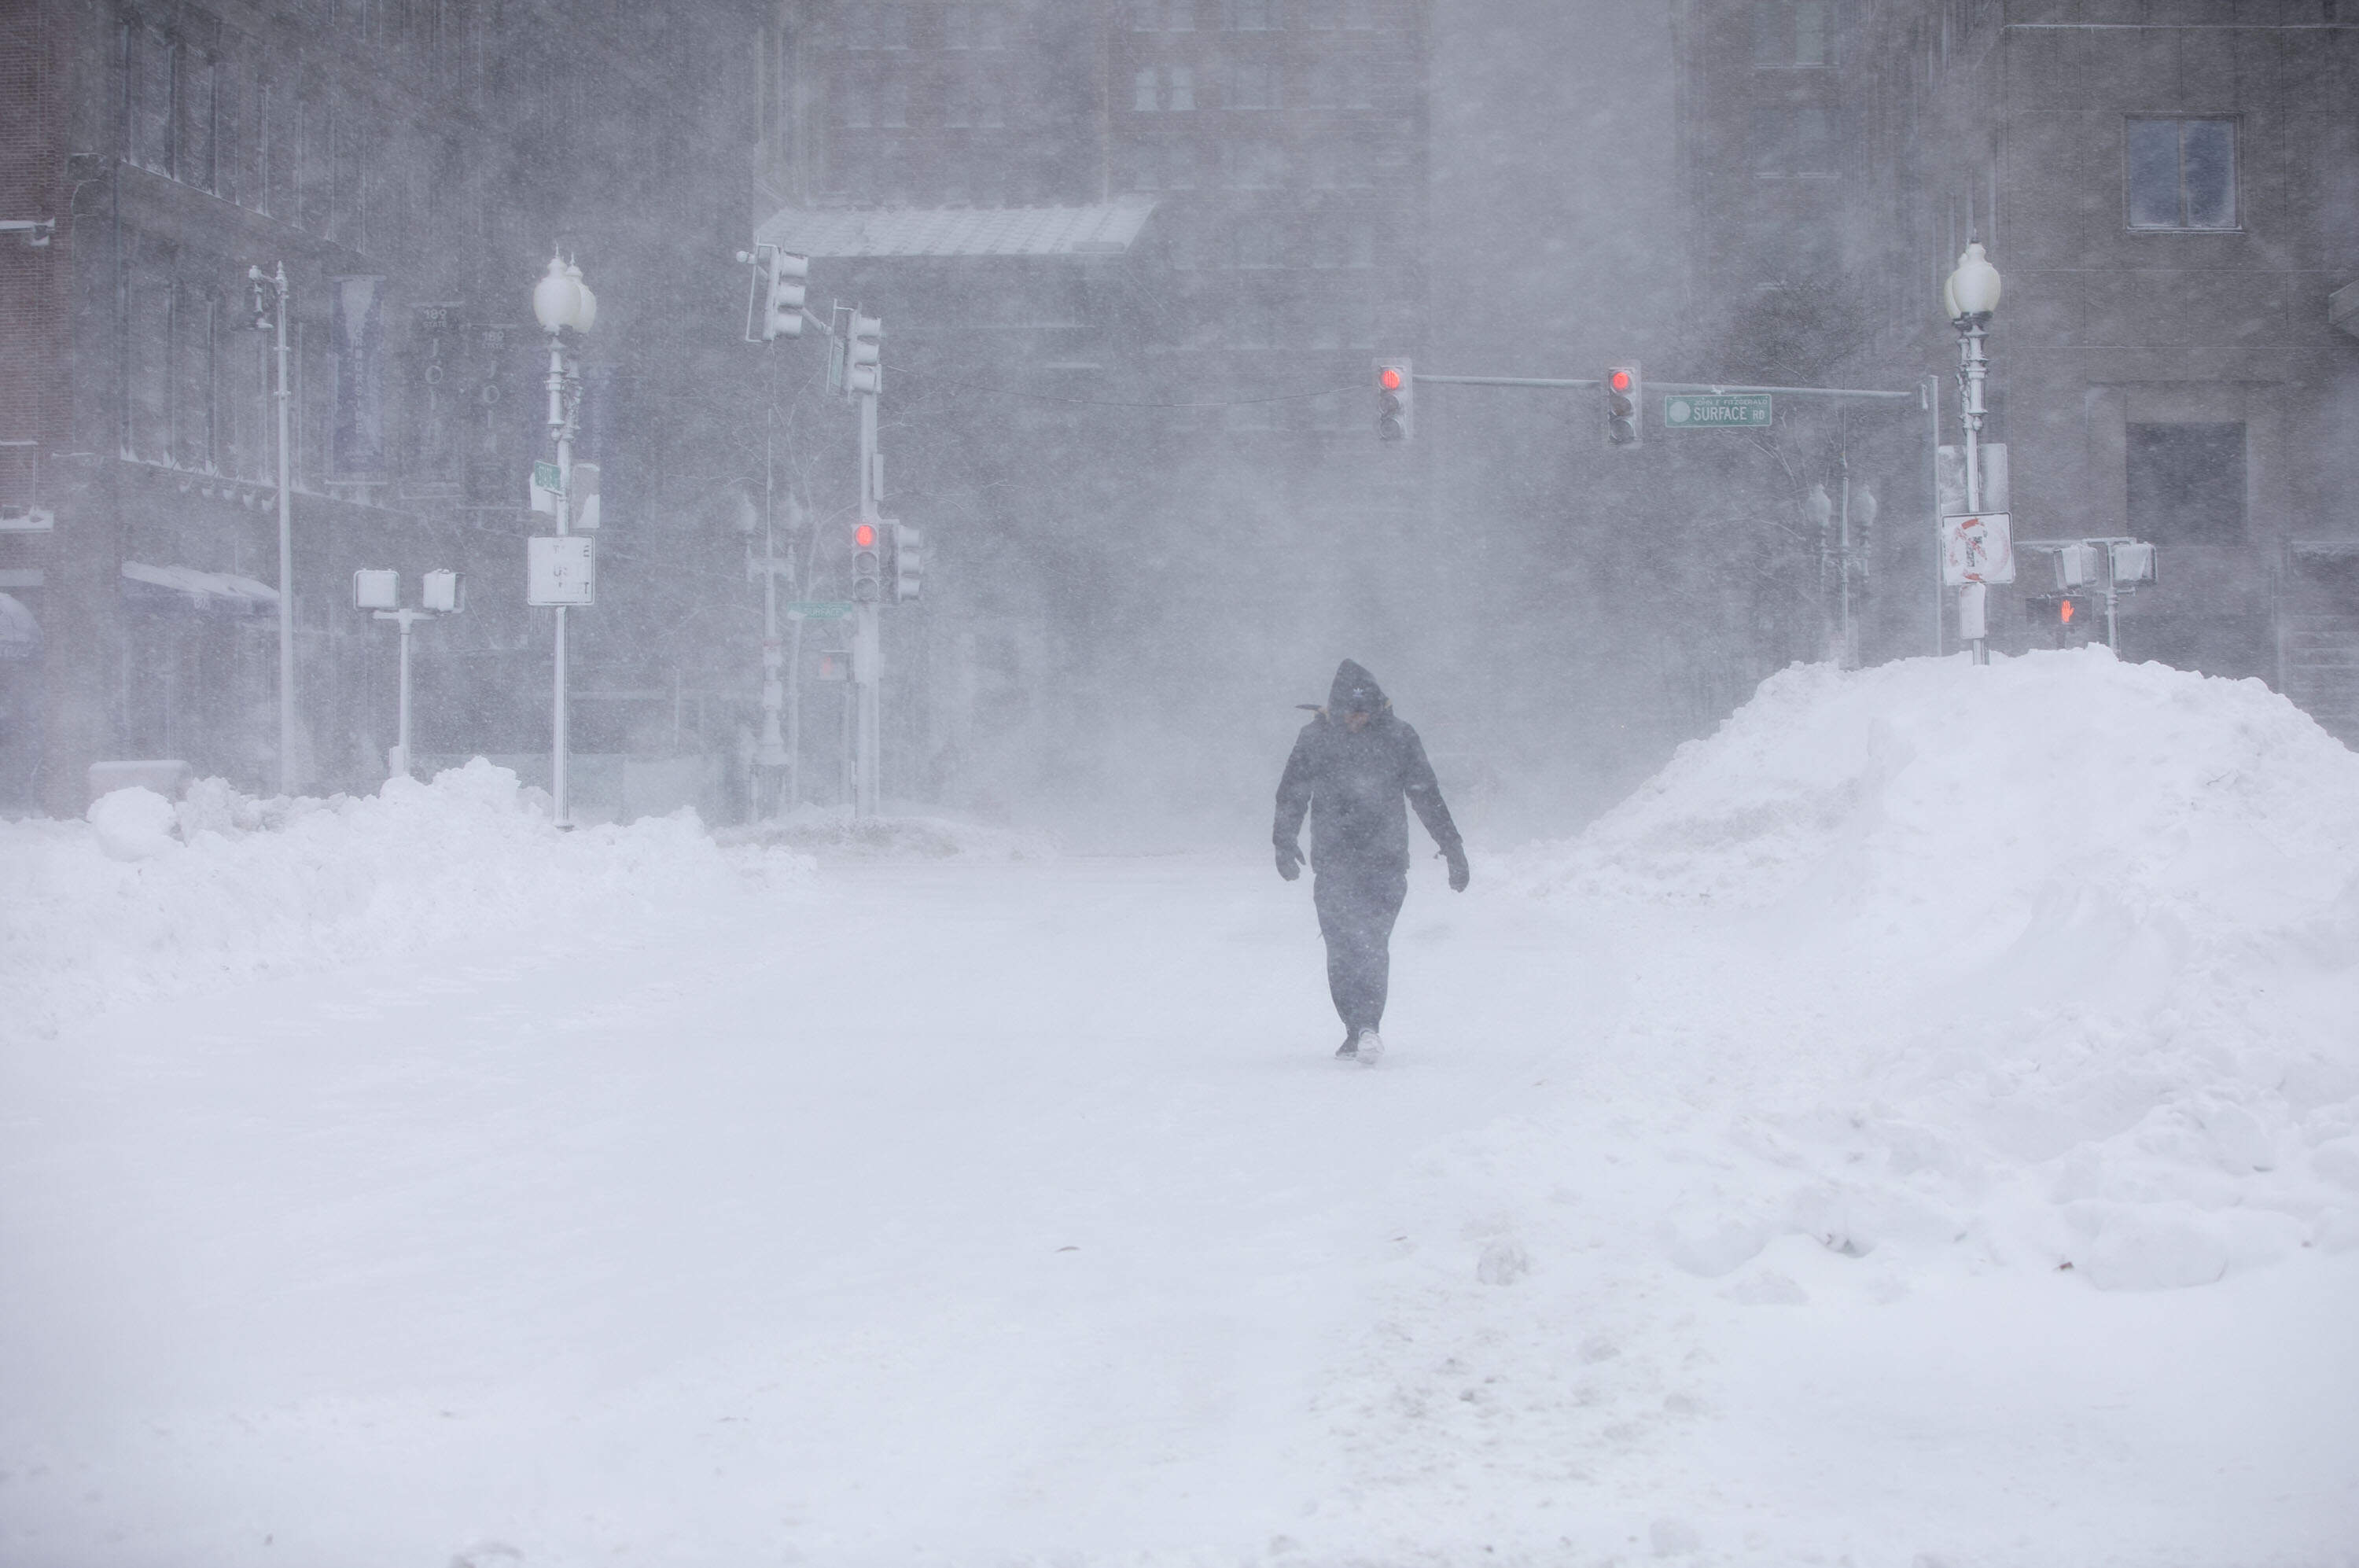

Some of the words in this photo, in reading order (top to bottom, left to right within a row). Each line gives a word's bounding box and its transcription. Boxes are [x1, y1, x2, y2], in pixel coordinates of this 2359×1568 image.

[423, 309, 447, 320] 189
[483, 331, 504, 341] 189
[1694, 407, 1747, 421] SURFACE
[1752, 410, 1765, 420] RD
